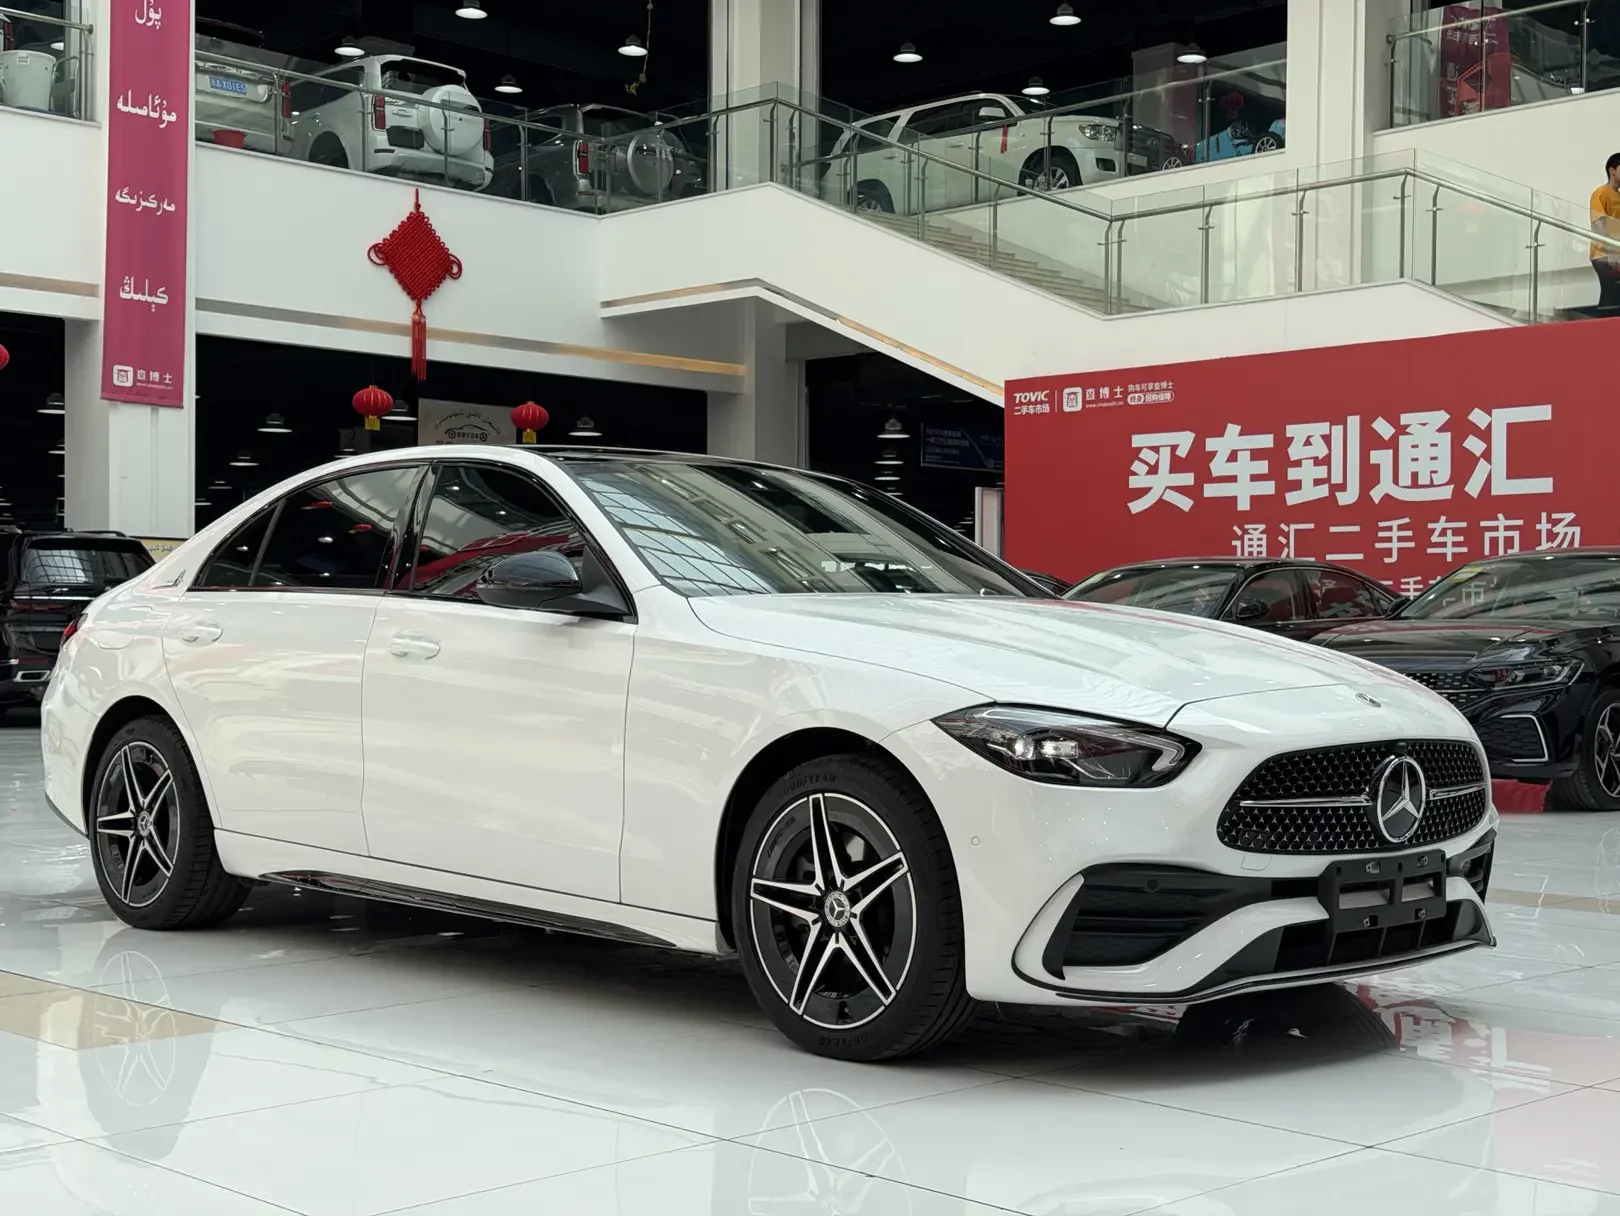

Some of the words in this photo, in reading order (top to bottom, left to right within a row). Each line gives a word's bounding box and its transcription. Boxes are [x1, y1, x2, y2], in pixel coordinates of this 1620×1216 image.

[1013, 390, 1050, 403] TOVIC
[1085, 385, 1124, 400] 查博士
[1013, 403, 1050, 415] 二手车市场
[1128, 404, 1554, 515] 买车到通汇
[1232, 512, 1581, 564] 通汇二手车市场
